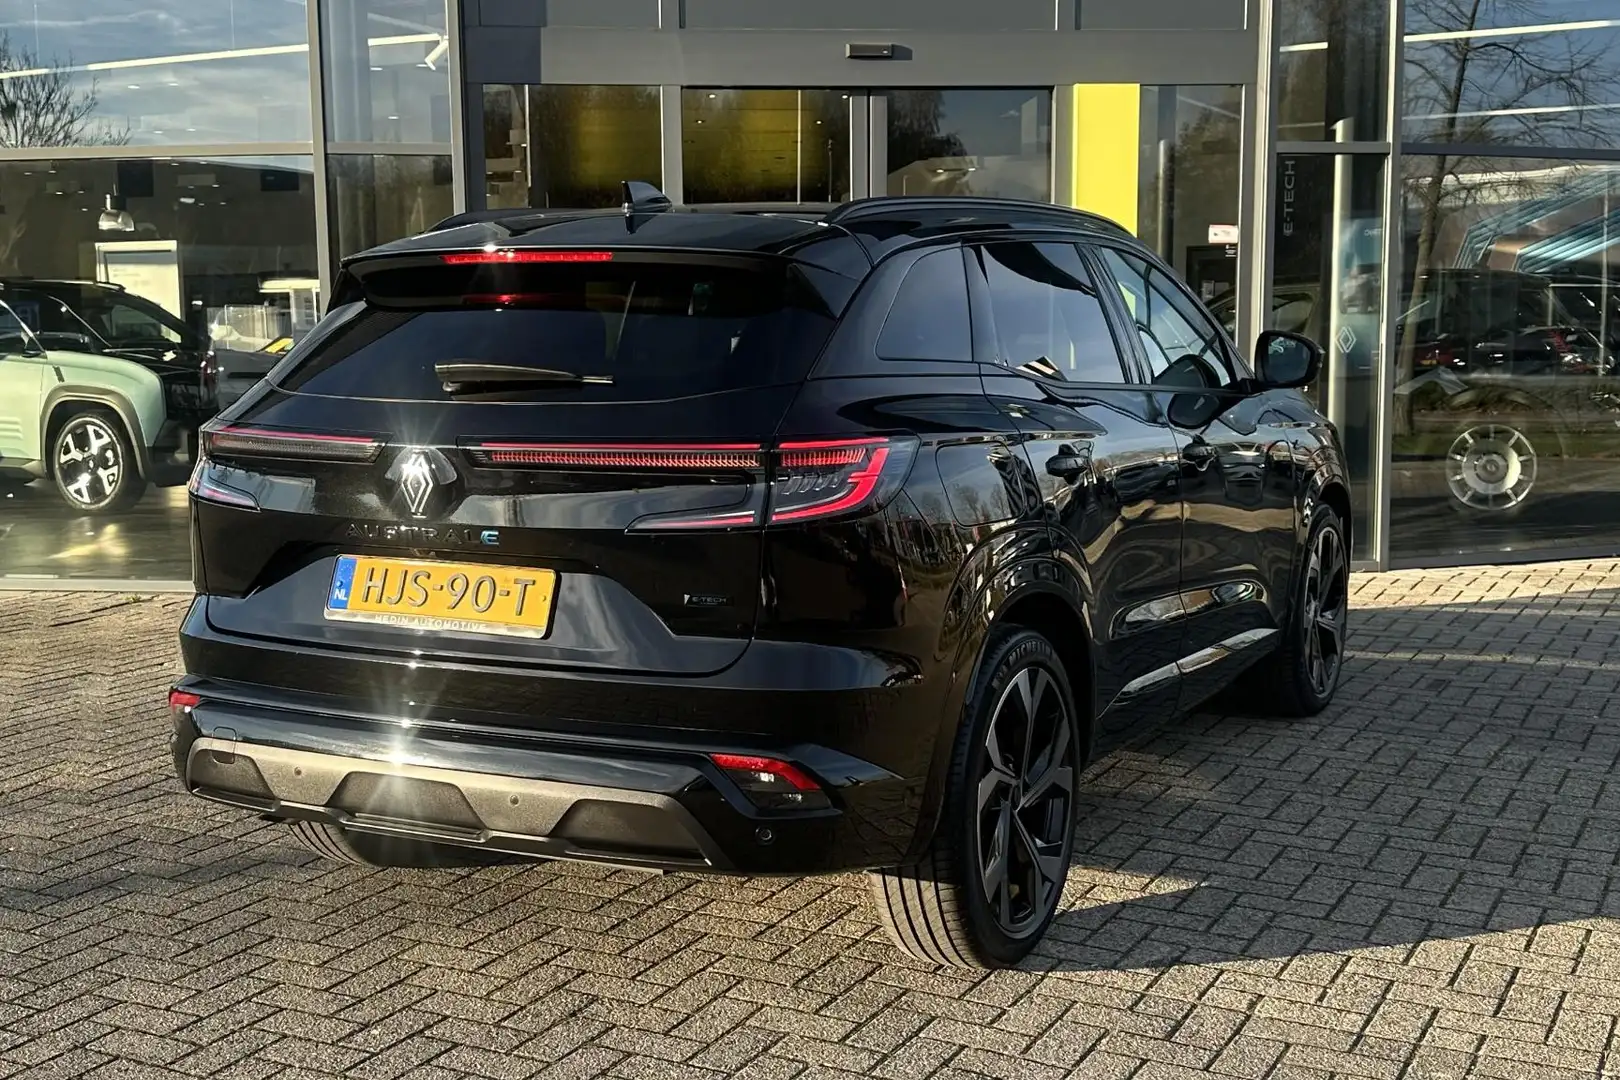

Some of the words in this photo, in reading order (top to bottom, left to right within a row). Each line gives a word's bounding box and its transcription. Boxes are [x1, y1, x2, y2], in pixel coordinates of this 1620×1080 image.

[1283, 161, 1295, 236] E-TECH
[334, 588, 348, 601] NL
[361, 567, 536, 616] HJS-90-T
[412, 616, 487, 630] AUTOMOTIVE
